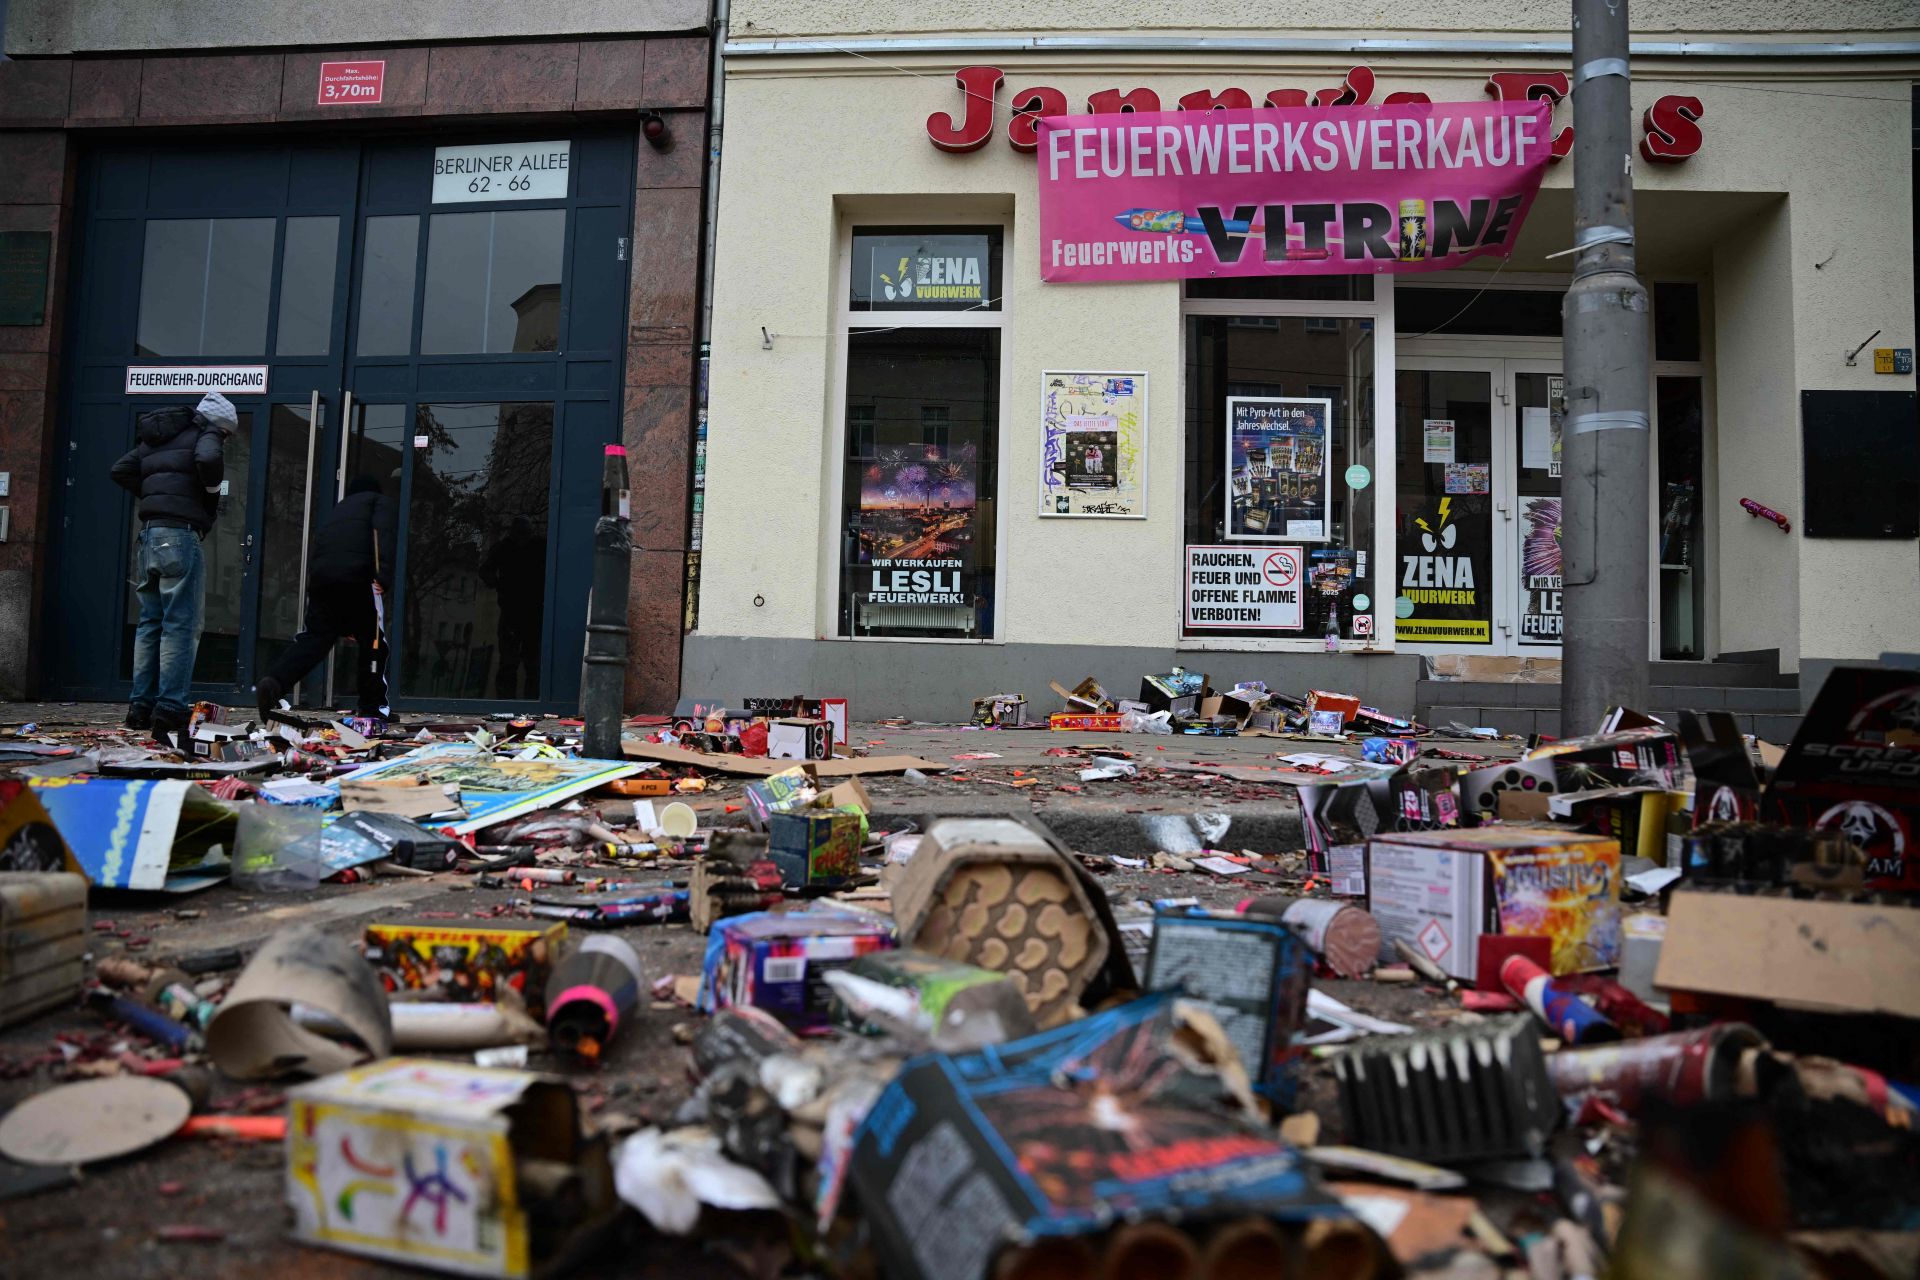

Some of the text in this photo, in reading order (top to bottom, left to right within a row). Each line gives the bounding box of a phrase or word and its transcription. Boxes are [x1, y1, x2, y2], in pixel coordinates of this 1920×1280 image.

[325, 84, 375, 99] 3,70m
[1048, 115, 1537, 181] FEUERWERKSVERKAUF
[435, 153, 569, 175] BERLINER ALLEE
[468, 176, 491, 193] 62
[508, 174, 531, 191] 66
[1052, 235, 1203, 267] Feuerwerks-
[916, 257, 981, 285] ZENA
[916, 285, 982, 299] VUURWERK
[129, 372, 264, 386] FEUERWEHR-DURCHGANG
[1236, 406, 1305, 420] Mit Pyro-Art in den
[1236, 420, 1291, 431] Jahreswechsel.
[872, 558, 963, 568] WIR VERKAUFEN
[1192, 553, 1256, 568] RAUCHEN,
[1192, 571, 1262, 585] FEUER UND
[1402, 555, 1475, 589] ZENA
[872, 570, 961, 593] LESLI
[1533, 576, 1549, 588] WIR
[868, 592, 964, 604] FEUERWERK!
[1192, 589, 1297, 604] OFFENE FLAMME
[1402, 588, 1476, 605] VUURWERK
[1192, 607, 1261, 621] VERBOTEN!
